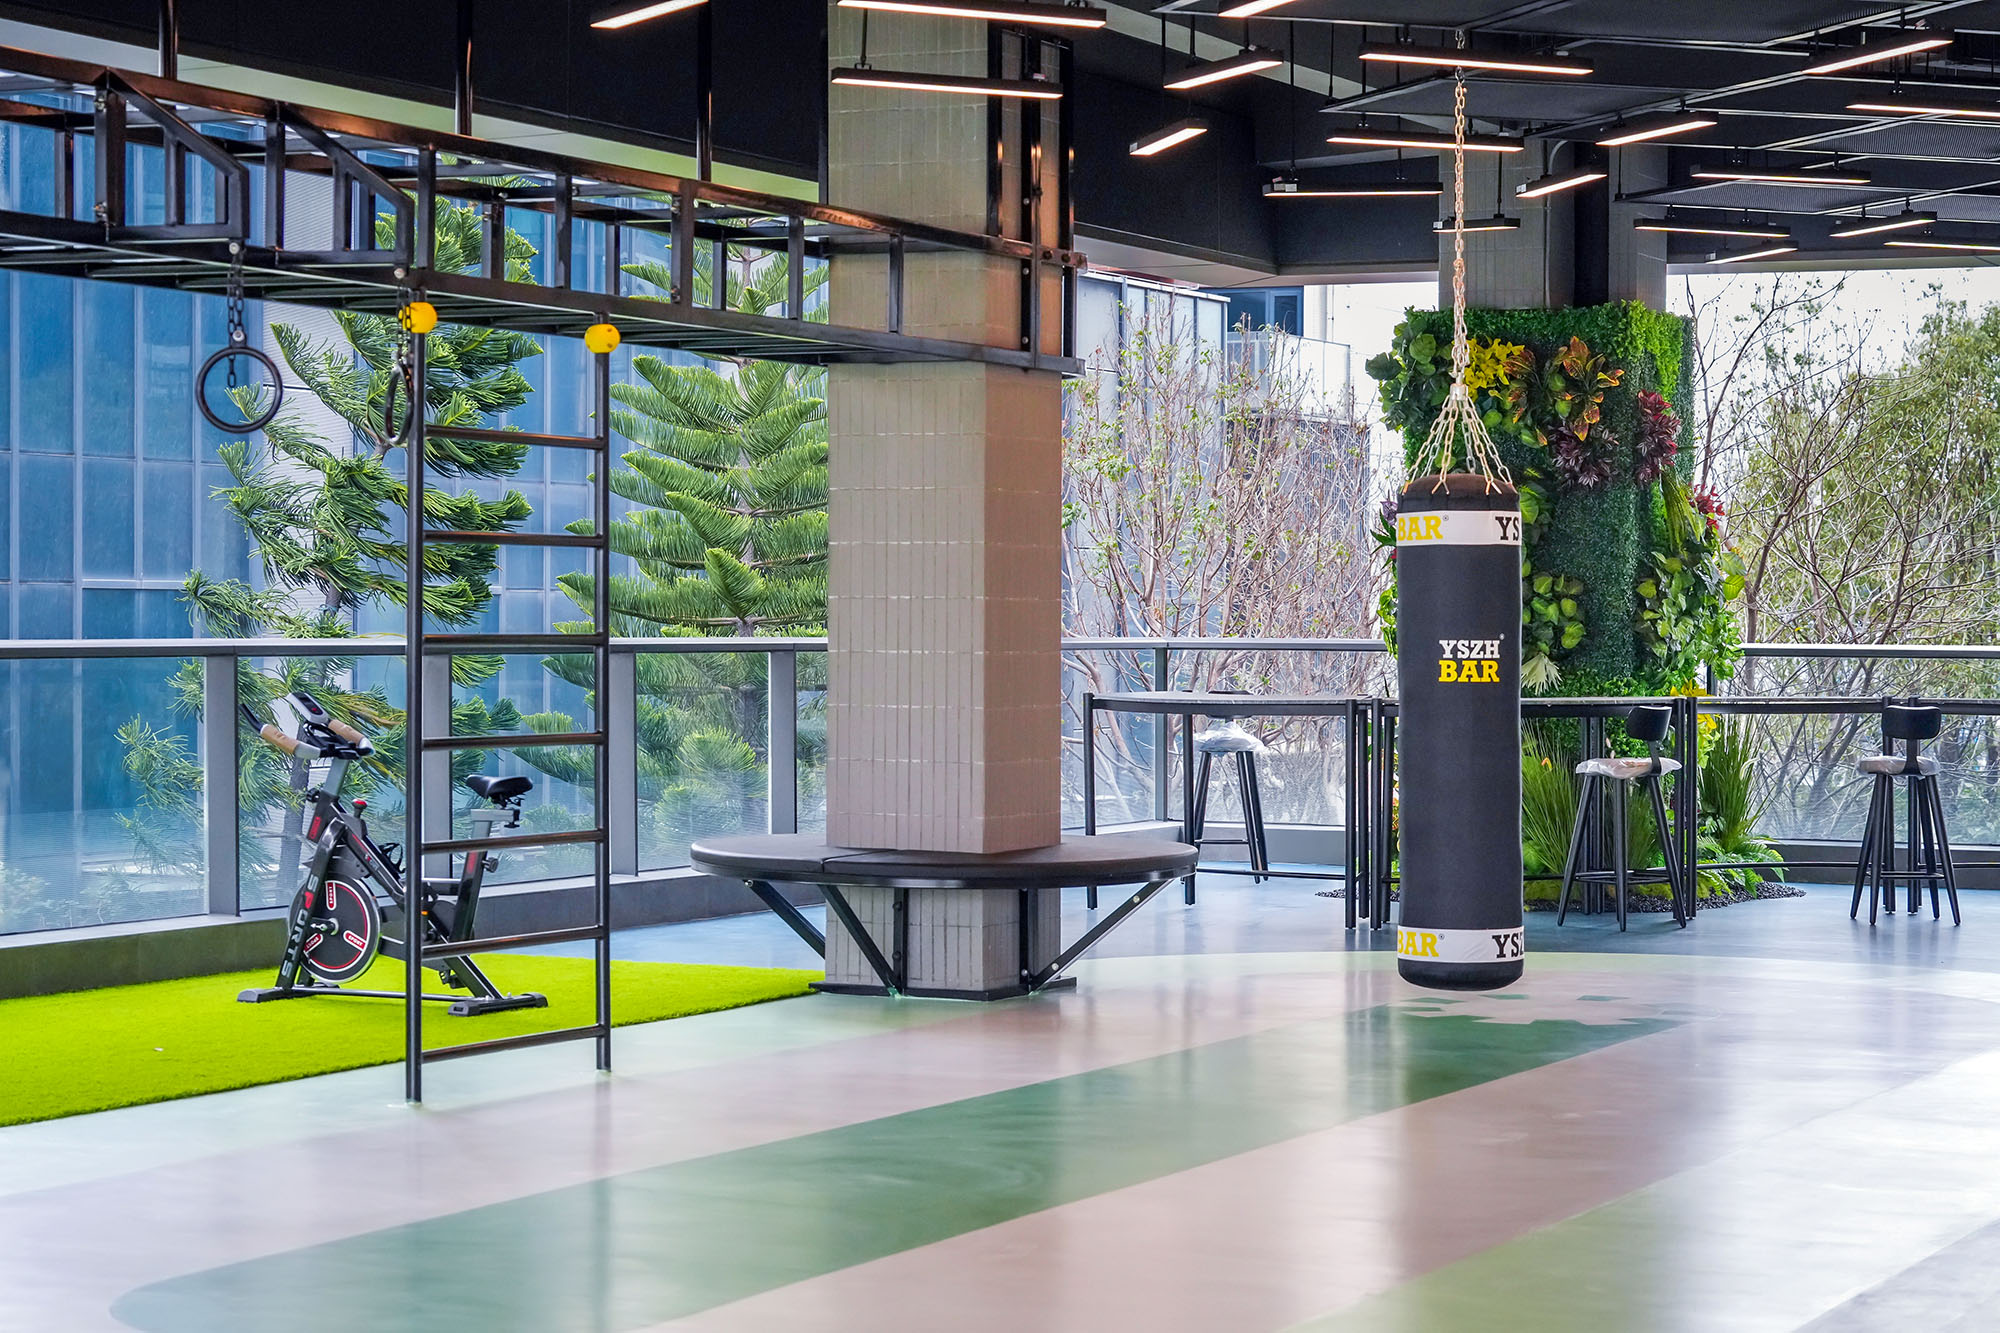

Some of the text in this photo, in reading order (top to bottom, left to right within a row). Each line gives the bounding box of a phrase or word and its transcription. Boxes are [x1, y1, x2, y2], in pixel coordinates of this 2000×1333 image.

[1398, 516, 1443, 541] BAR
[1439, 640, 1500, 659] YSZH
[1438, 660, 1500, 683] BAR
[281, 874, 319, 978] SPORTS
[347, 935, 364, 947] SPORT
[1398, 930, 1439, 957] BAR
